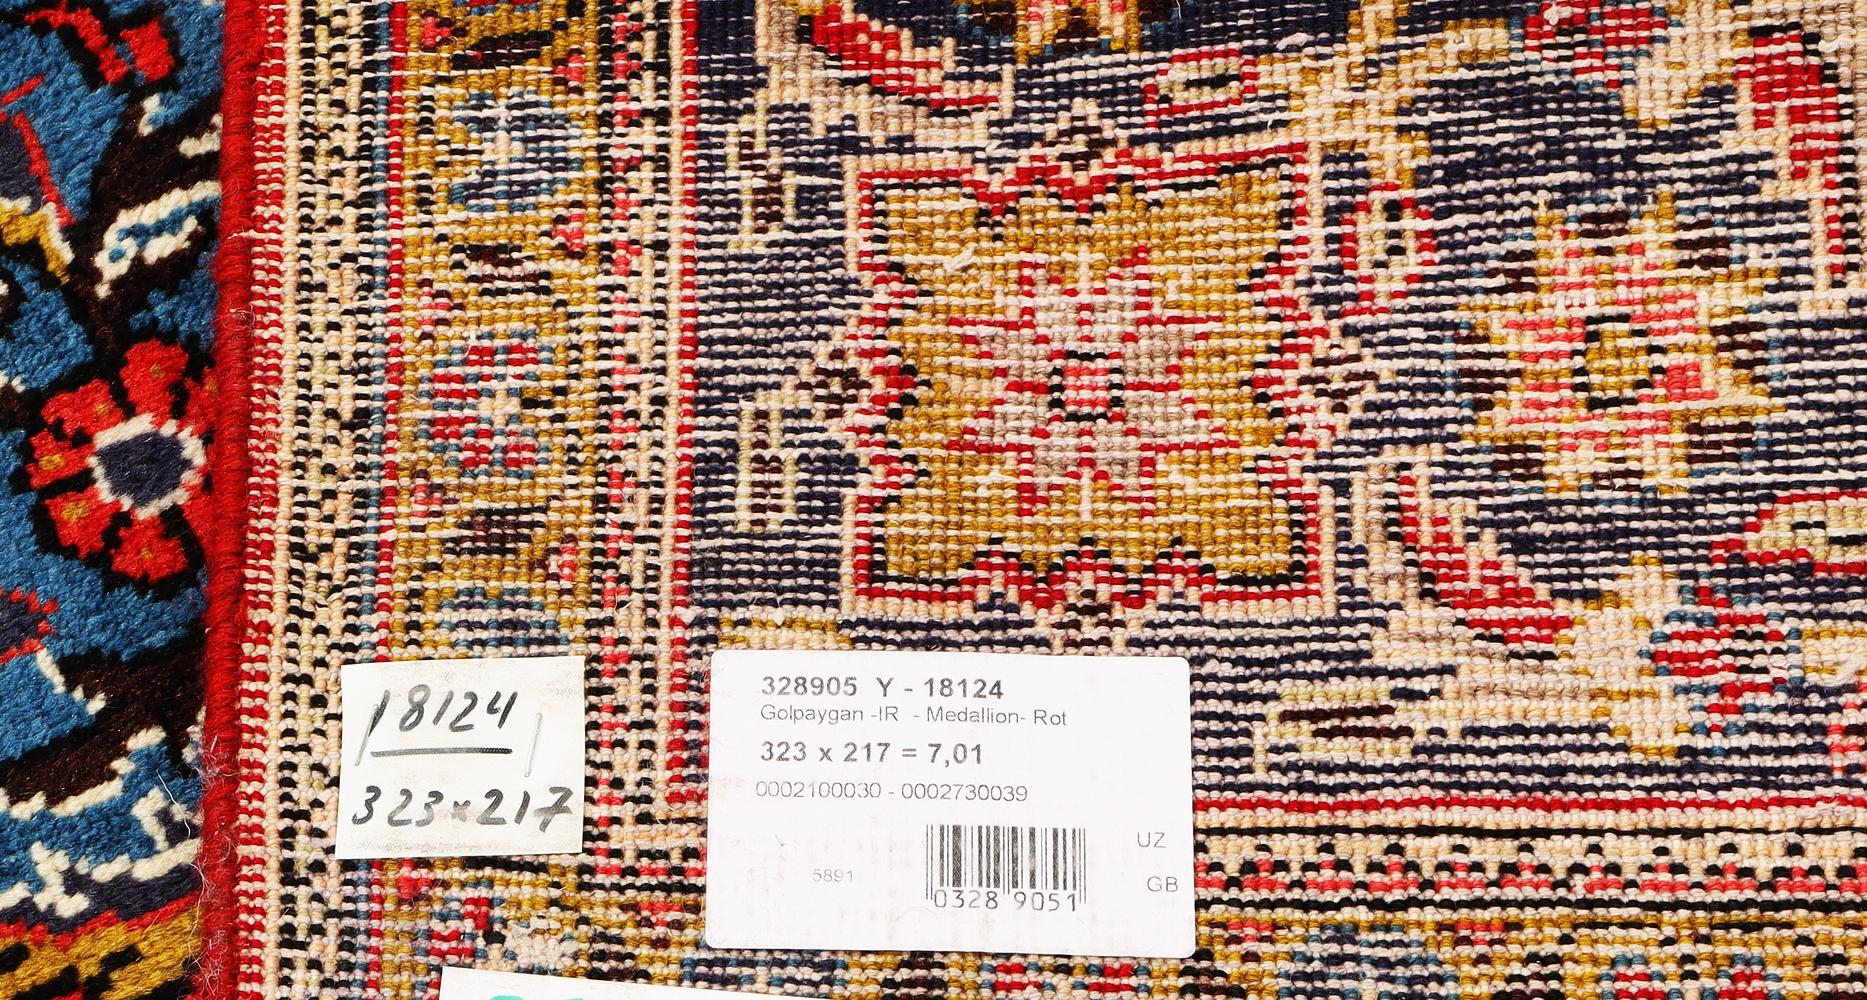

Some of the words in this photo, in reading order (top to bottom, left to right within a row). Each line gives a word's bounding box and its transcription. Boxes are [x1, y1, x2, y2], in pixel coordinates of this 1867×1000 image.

[762, 676, 857, 696] 328905
[876, 677, 894, 697] Y
[924, 677, 1003, 699] 18124
[366, 684, 518, 732] 18124
[761, 704, 863, 724] Golpaygan
[1034, 709, 1067, 725] Rot
[761, 741, 807, 761] 323
[843, 742, 890, 762] 217
[928, 743, 981, 768] 7,01
[756, 781, 881, 798] 0002100030
[902, 783, 1027, 801] 0002730039
[1137, 832, 1165, 848] UZ
[813, 869, 852, 882] 5891
[1147, 876, 1178, 892] GB
